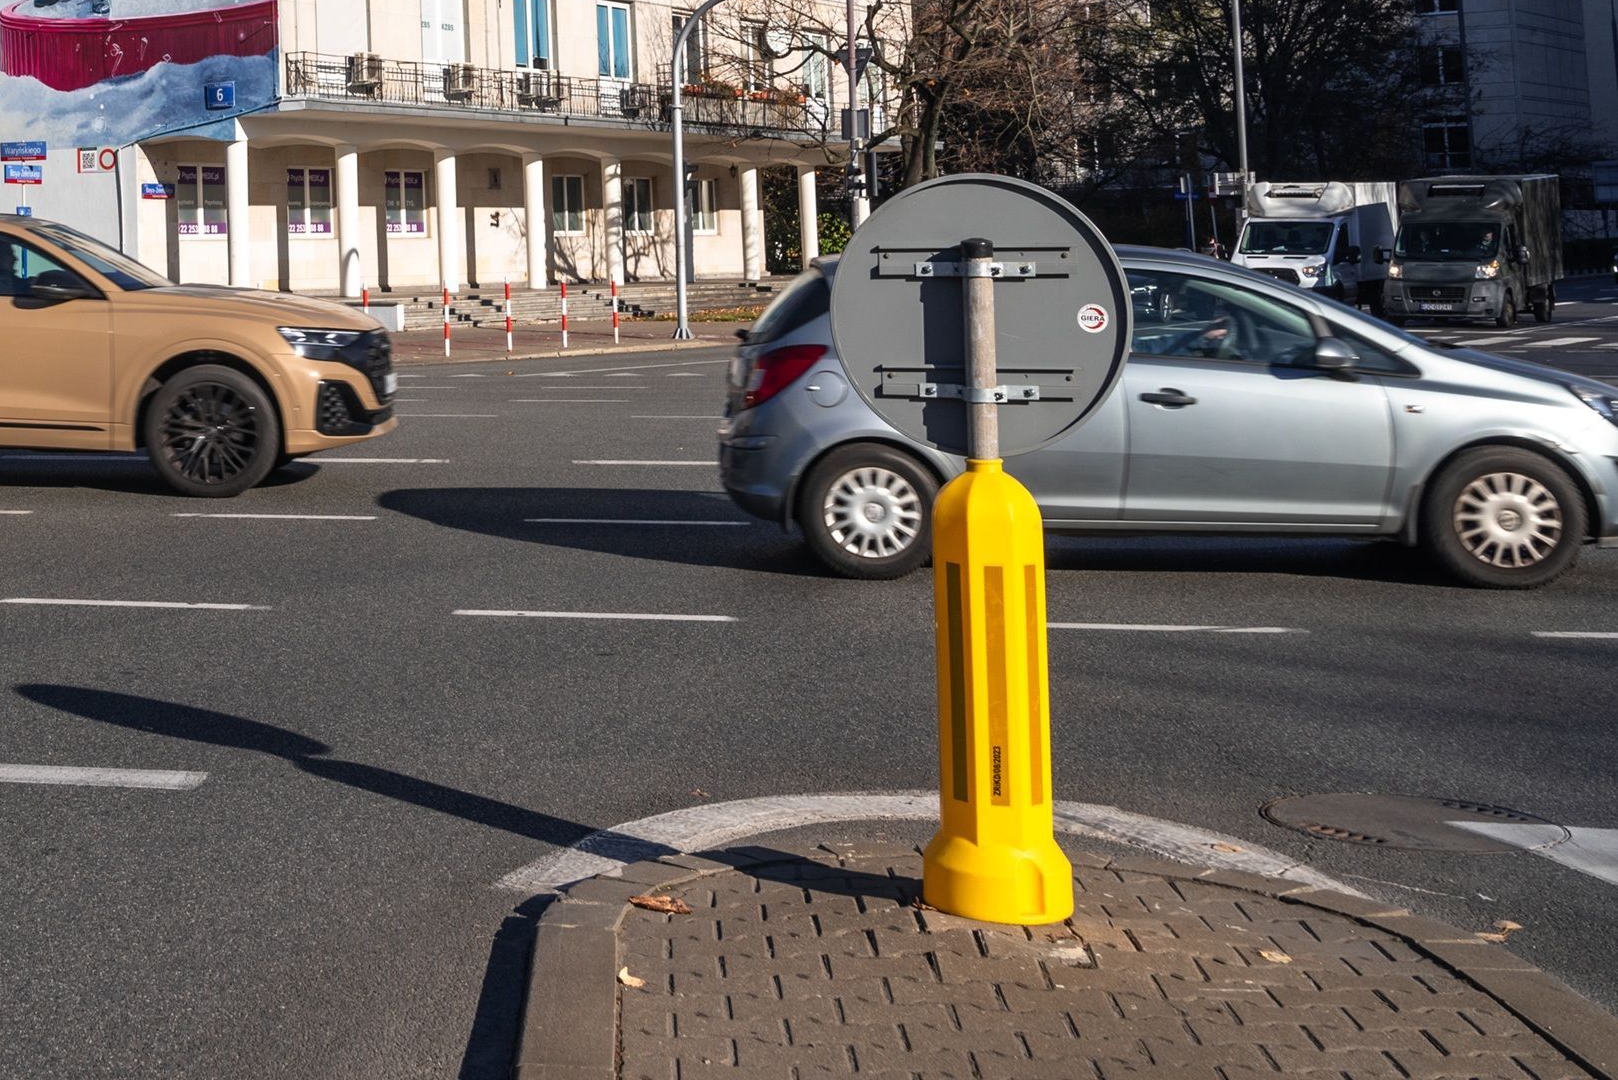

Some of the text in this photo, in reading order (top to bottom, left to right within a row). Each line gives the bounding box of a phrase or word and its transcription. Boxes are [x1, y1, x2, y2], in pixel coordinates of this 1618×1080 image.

[216, 88, 224, 101] 6
[4, 146, 42, 156] Waryńskiego
[180, 225, 187, 233] 22
[289, 224, 295, 232] 22
[387, 224, 393, 232] 22
